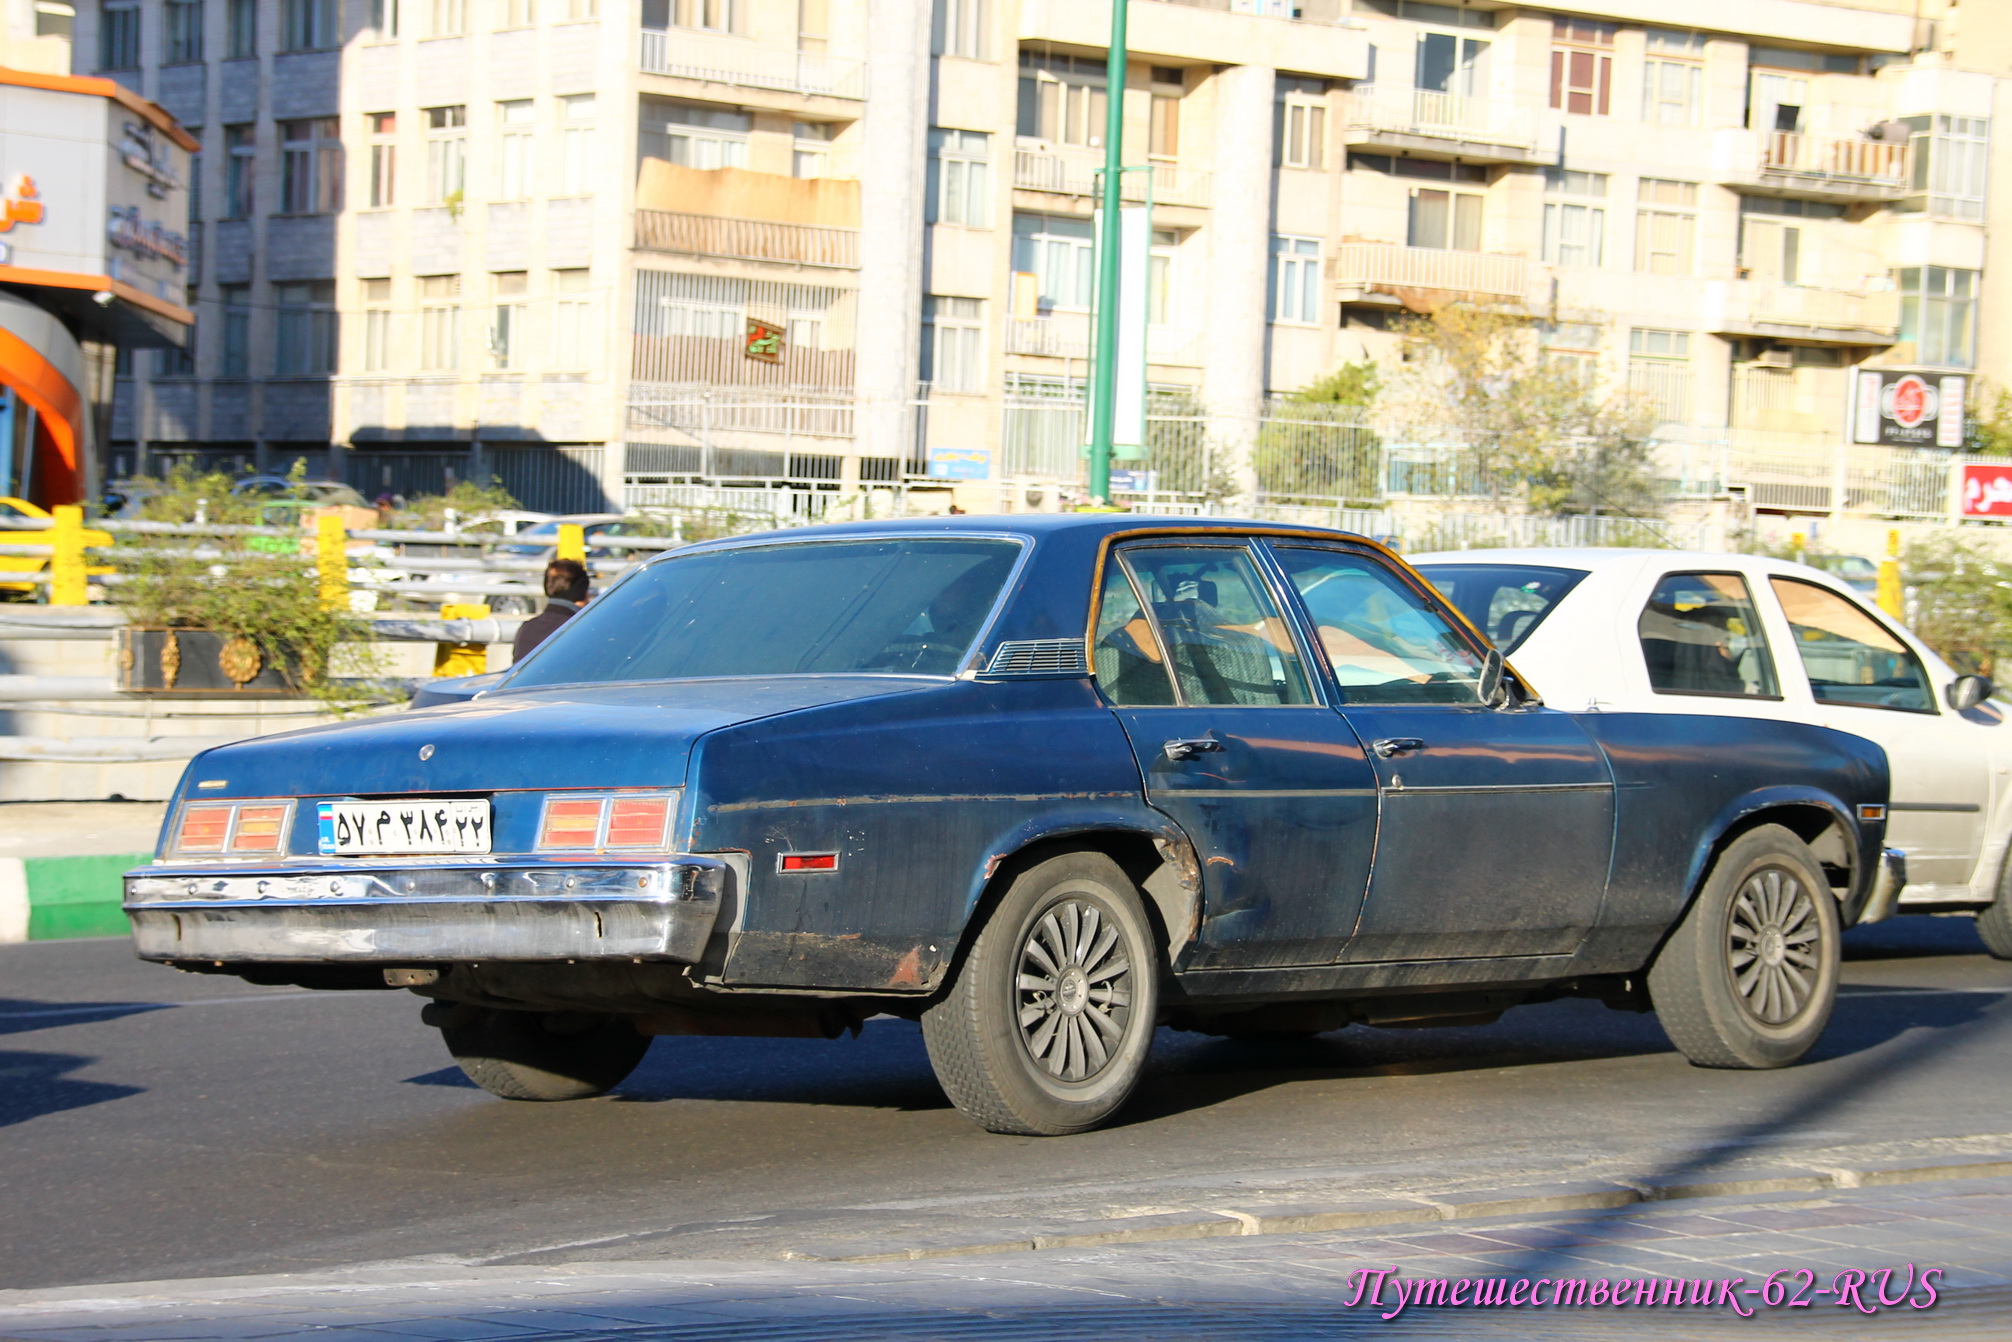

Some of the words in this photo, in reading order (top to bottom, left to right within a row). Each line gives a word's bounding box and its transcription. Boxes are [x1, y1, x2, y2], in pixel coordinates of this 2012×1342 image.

[337, 811, 366, 847] ۵۷
[376, 810, 391, 846] م
[400, 809, 448, 845] ۳۸۴
[455, 815, 484, 847] ۲۲
